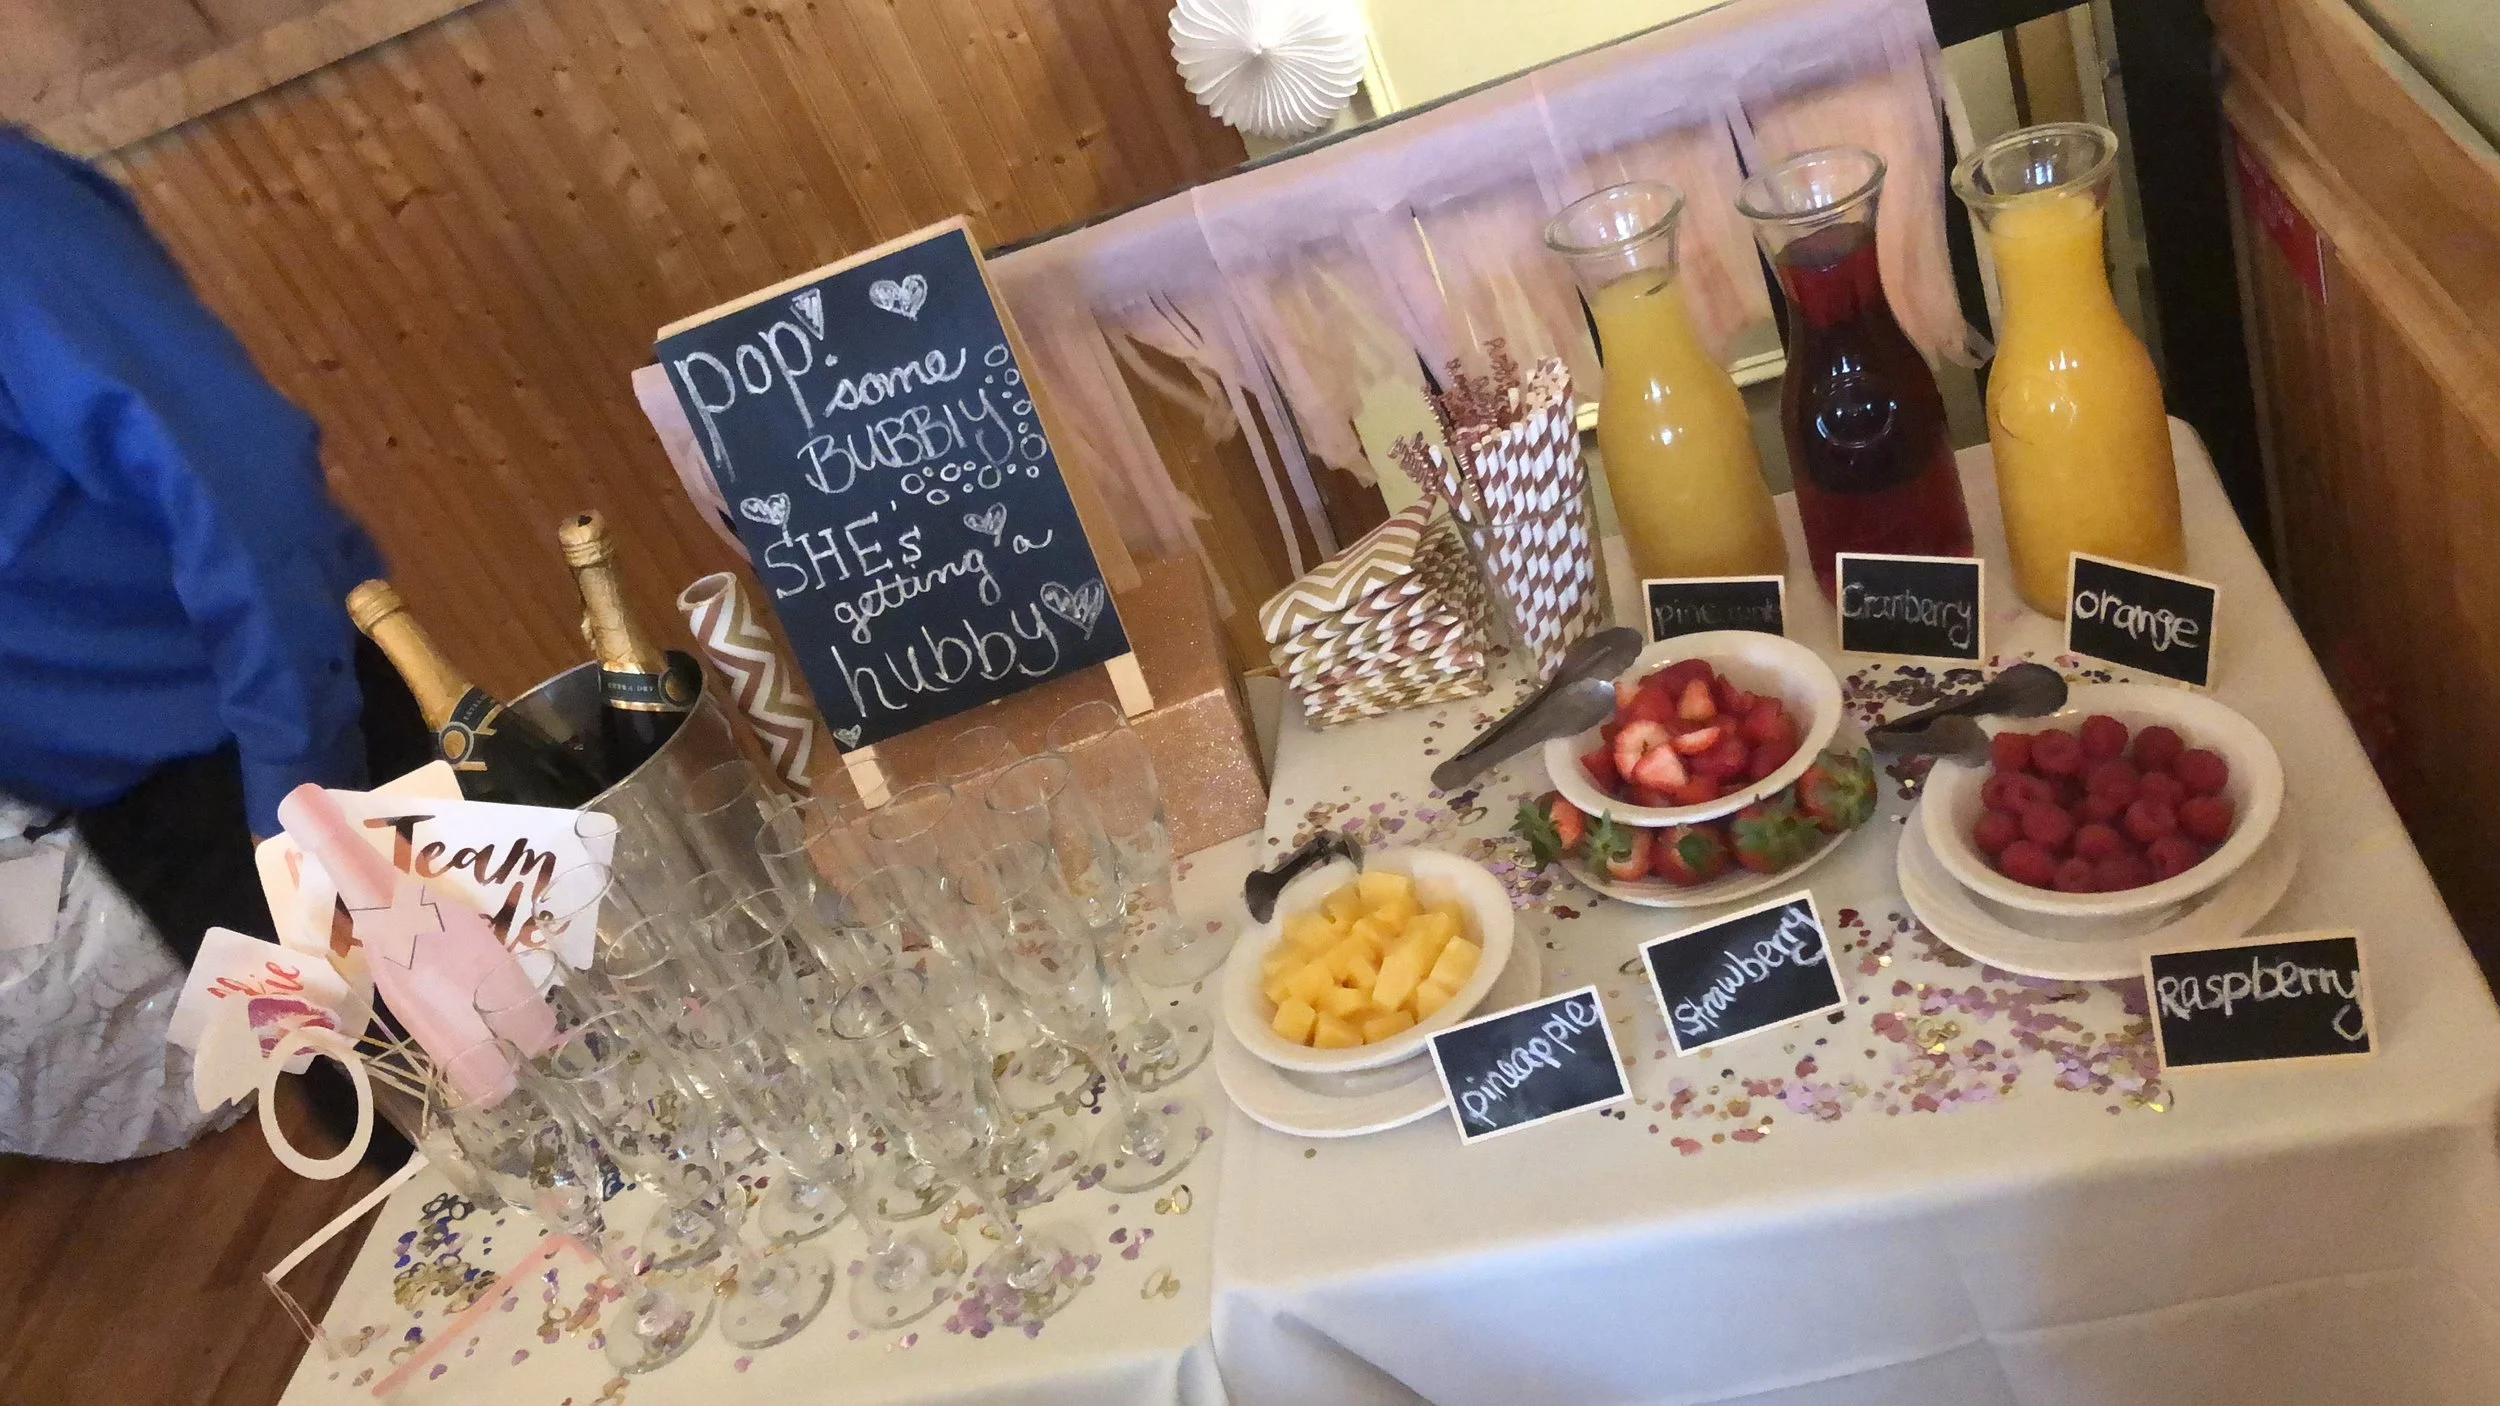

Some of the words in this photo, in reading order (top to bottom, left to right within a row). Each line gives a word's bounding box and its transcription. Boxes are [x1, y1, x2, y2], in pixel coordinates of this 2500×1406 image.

[824, 347, 967, 417] some
[833, 549, 1000, 643] getting
[1013, 529, 1053, 553] a
[1841, 581, 1973, 650] Cranberry
[2074, 588, 2199, 652] orange
[831, 602, 1060, 718] hubby
[363, 814, 557, 901] Team
[1673, 907, 1826, 1038] Strawberry
[2157, 956, 2367, 1042] Raspberry
[1461, 999, 1600, 1129] pineapple
